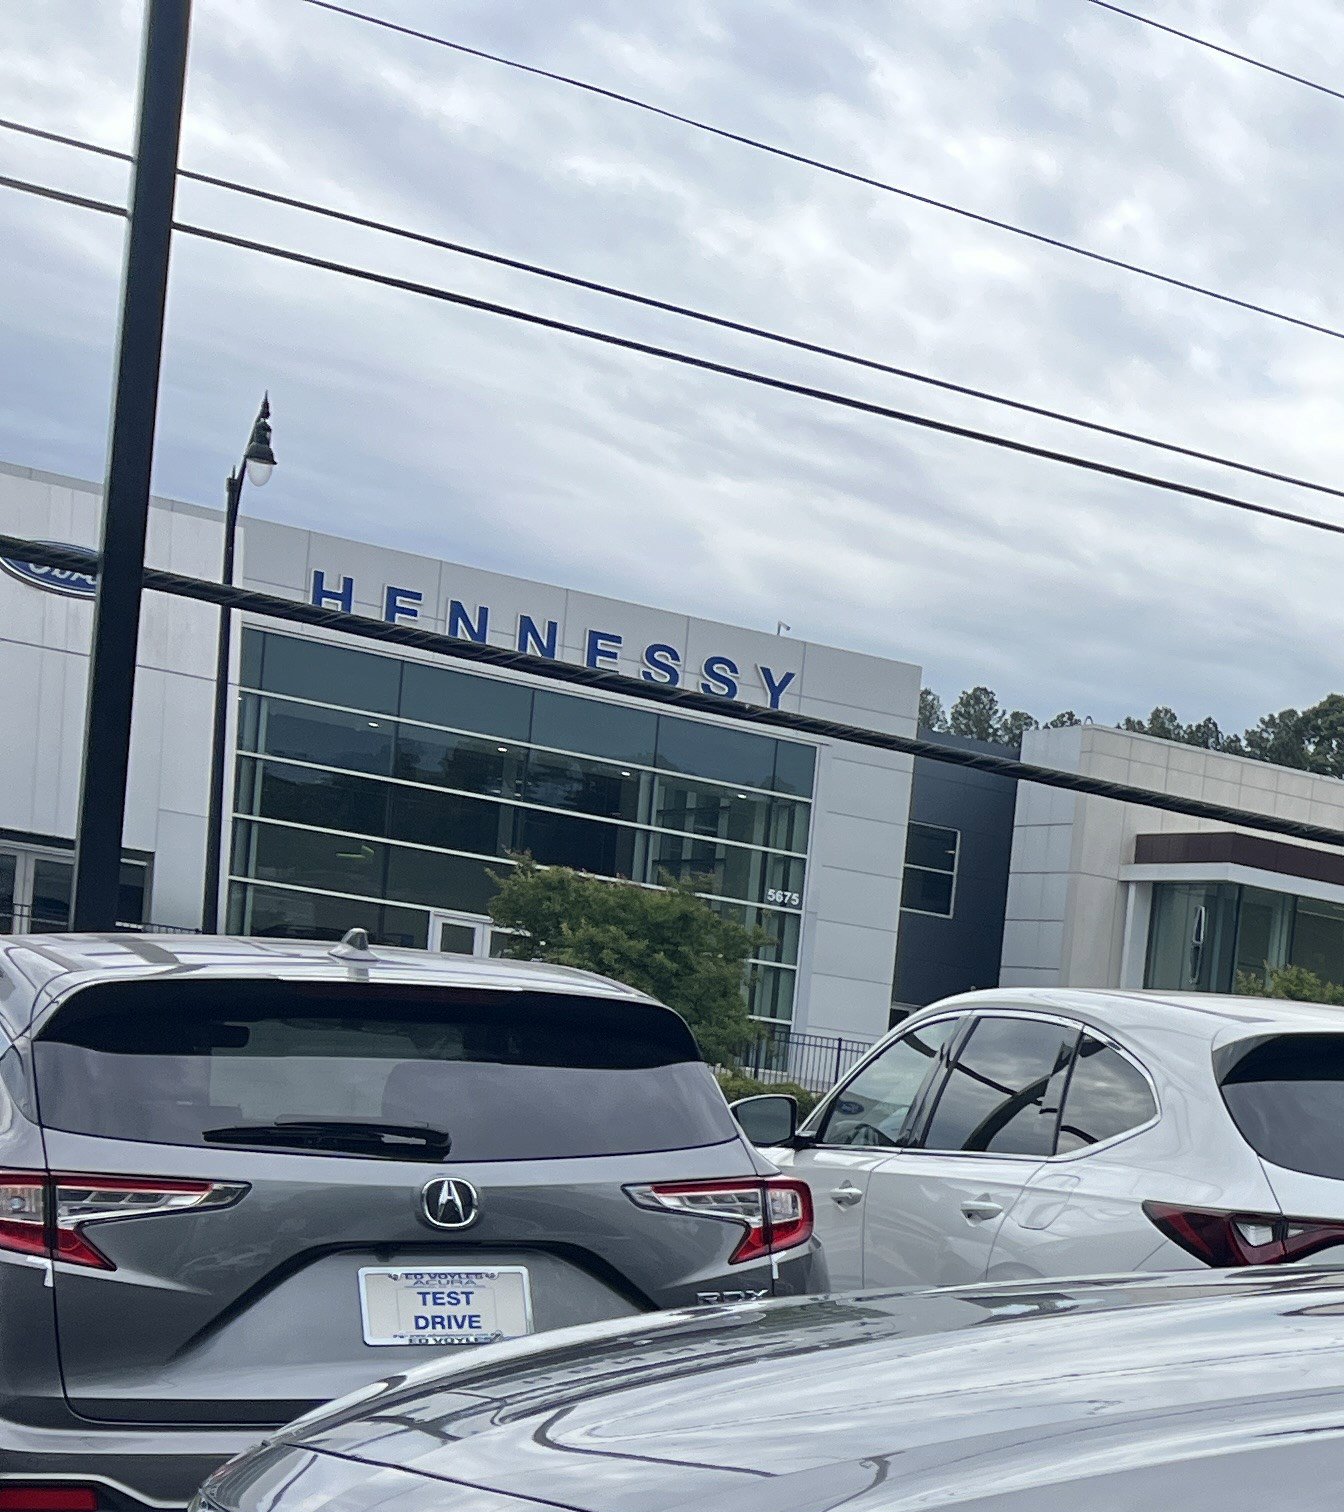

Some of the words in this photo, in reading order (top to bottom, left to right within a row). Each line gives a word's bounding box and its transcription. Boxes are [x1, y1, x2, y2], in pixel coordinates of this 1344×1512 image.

[309, 569, 797, 709] HENNESSY
[767, 888, 800, 906] 5675
[416, 1291, 475, 1306] TEST
[413, 1314, 482, 1331] DRIVE
